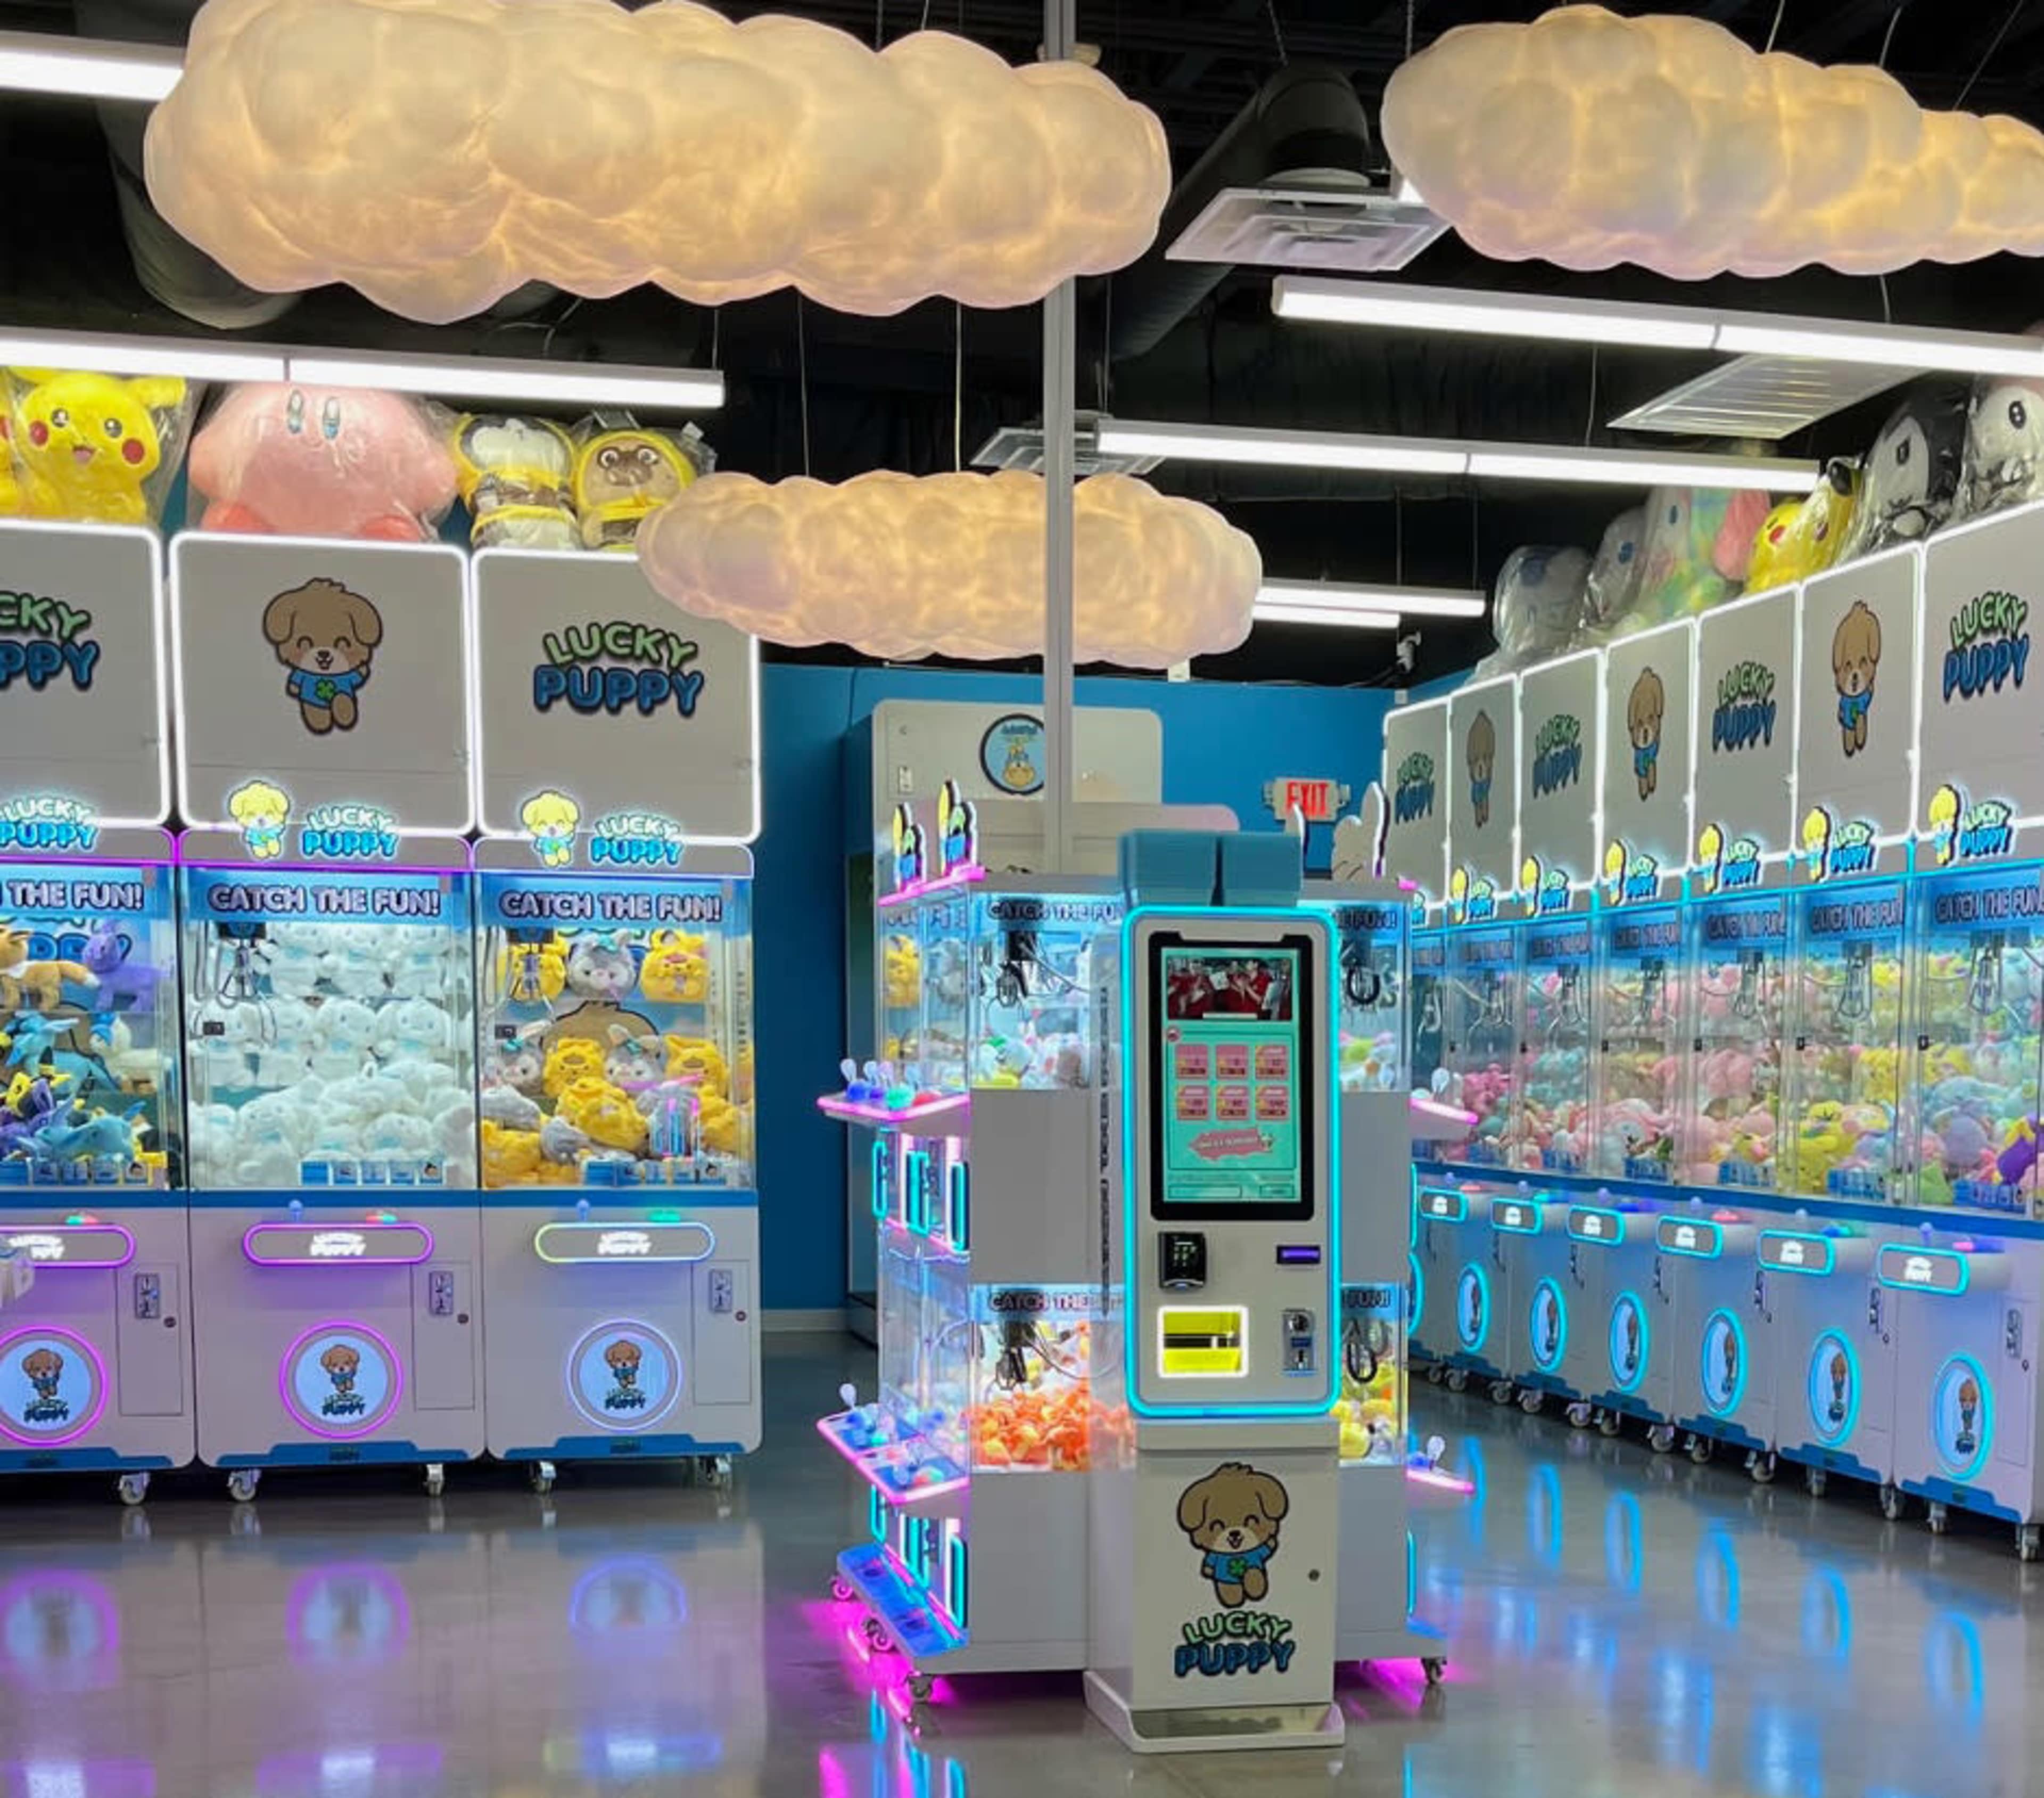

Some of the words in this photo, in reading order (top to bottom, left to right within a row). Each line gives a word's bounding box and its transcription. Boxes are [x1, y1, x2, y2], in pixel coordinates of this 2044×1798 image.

[1950, 590, 2028, 651] LUCKY
[543, 622, 697, 668] LUCKY
[1718, 661, 1775, 709] LUCKY
[1943, 633, 2030, 704] PUPPY
[533, 664, 704, 717] PUPPY
[2, 798, 92, 823] LUCKY
[1287, 781, 1329, 817] EXIT
[0, 821, 97, 849] PUPPY
[307, 806, 395, 832] LUCKY
[594, 815, 681, 840] LUCKY
[302, 830, 399, 857] PUPPY
[591, 837, 684, 865] PUPPY
[6, 880, 67, 909] THE
[72, 881, 144, 910] FUN!
[208, 883, 307, 913] CATCH
[310, 884, 368, 914] THE
[373, 887, 441, 917] FUN!
[499, 890, 594, 919] CATCH
[597, 891, 652, 920] THE
[655, 893, 722, 922] FUN!
[1183, 1611, 1292, 1645] LUCKY
[1174, 1640, 1296, 1678] PUPPY
